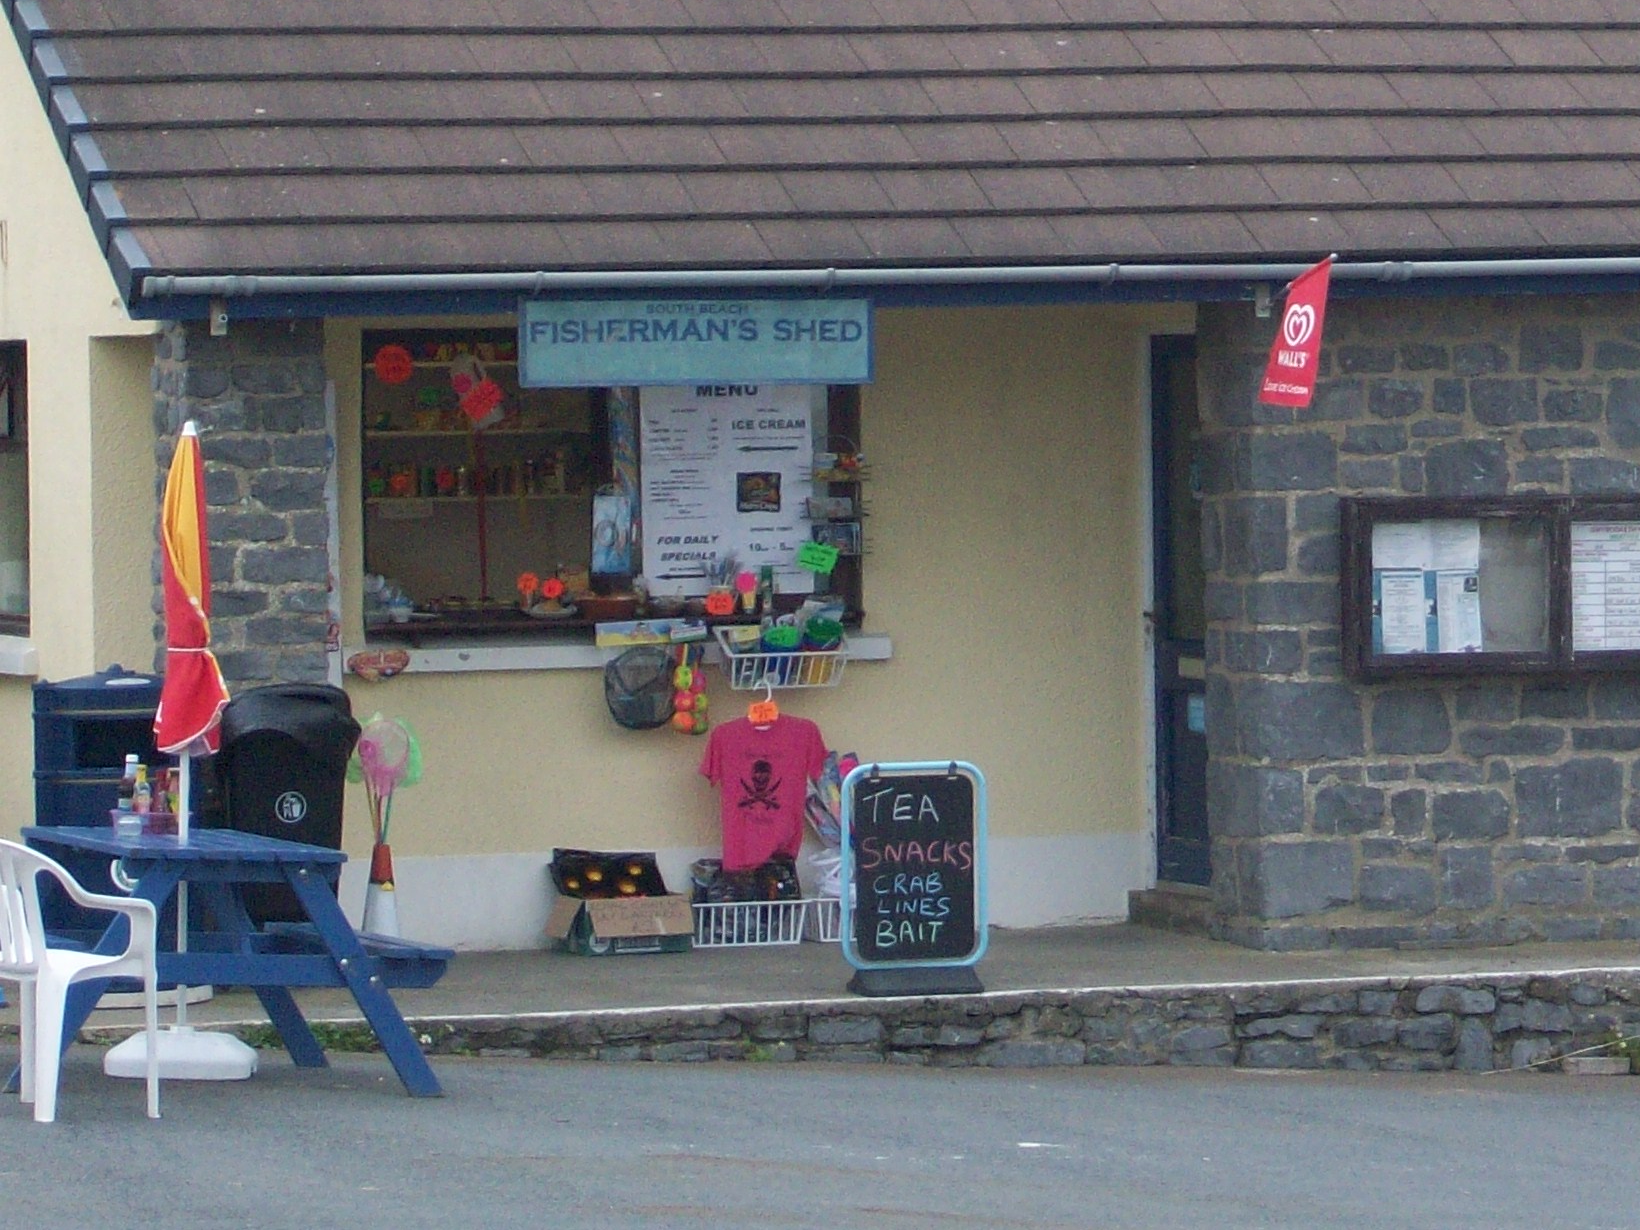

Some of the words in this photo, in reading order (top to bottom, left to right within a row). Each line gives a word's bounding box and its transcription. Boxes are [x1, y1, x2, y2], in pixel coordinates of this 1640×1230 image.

[646, 303, 694, 315] SOUTH
[700, 303, 745, 315] BEACH
[528, 319, 759, 344] FISHERMAN'S
[772, 319, 863, 343] SHED
[1277, 350, 1307, 368] WALL'S
[696, 385, 758, 397] MENU
[731, 419, 754, 430] ICE
[758, 418, 806, 429] CREAM
[657, 536, 682, 545] FOR
[684, 535, 719, 545] DAILY
[660, 551, 717, 561] SPECIALS
[862, 787, 940, 823] TEA
[861, 836, 972, 870] SNACKS
[873, 871, 944, 895] CRAB
[877, 896, 951, 917] LINES
[875, 919, 943, 948] BAIT
